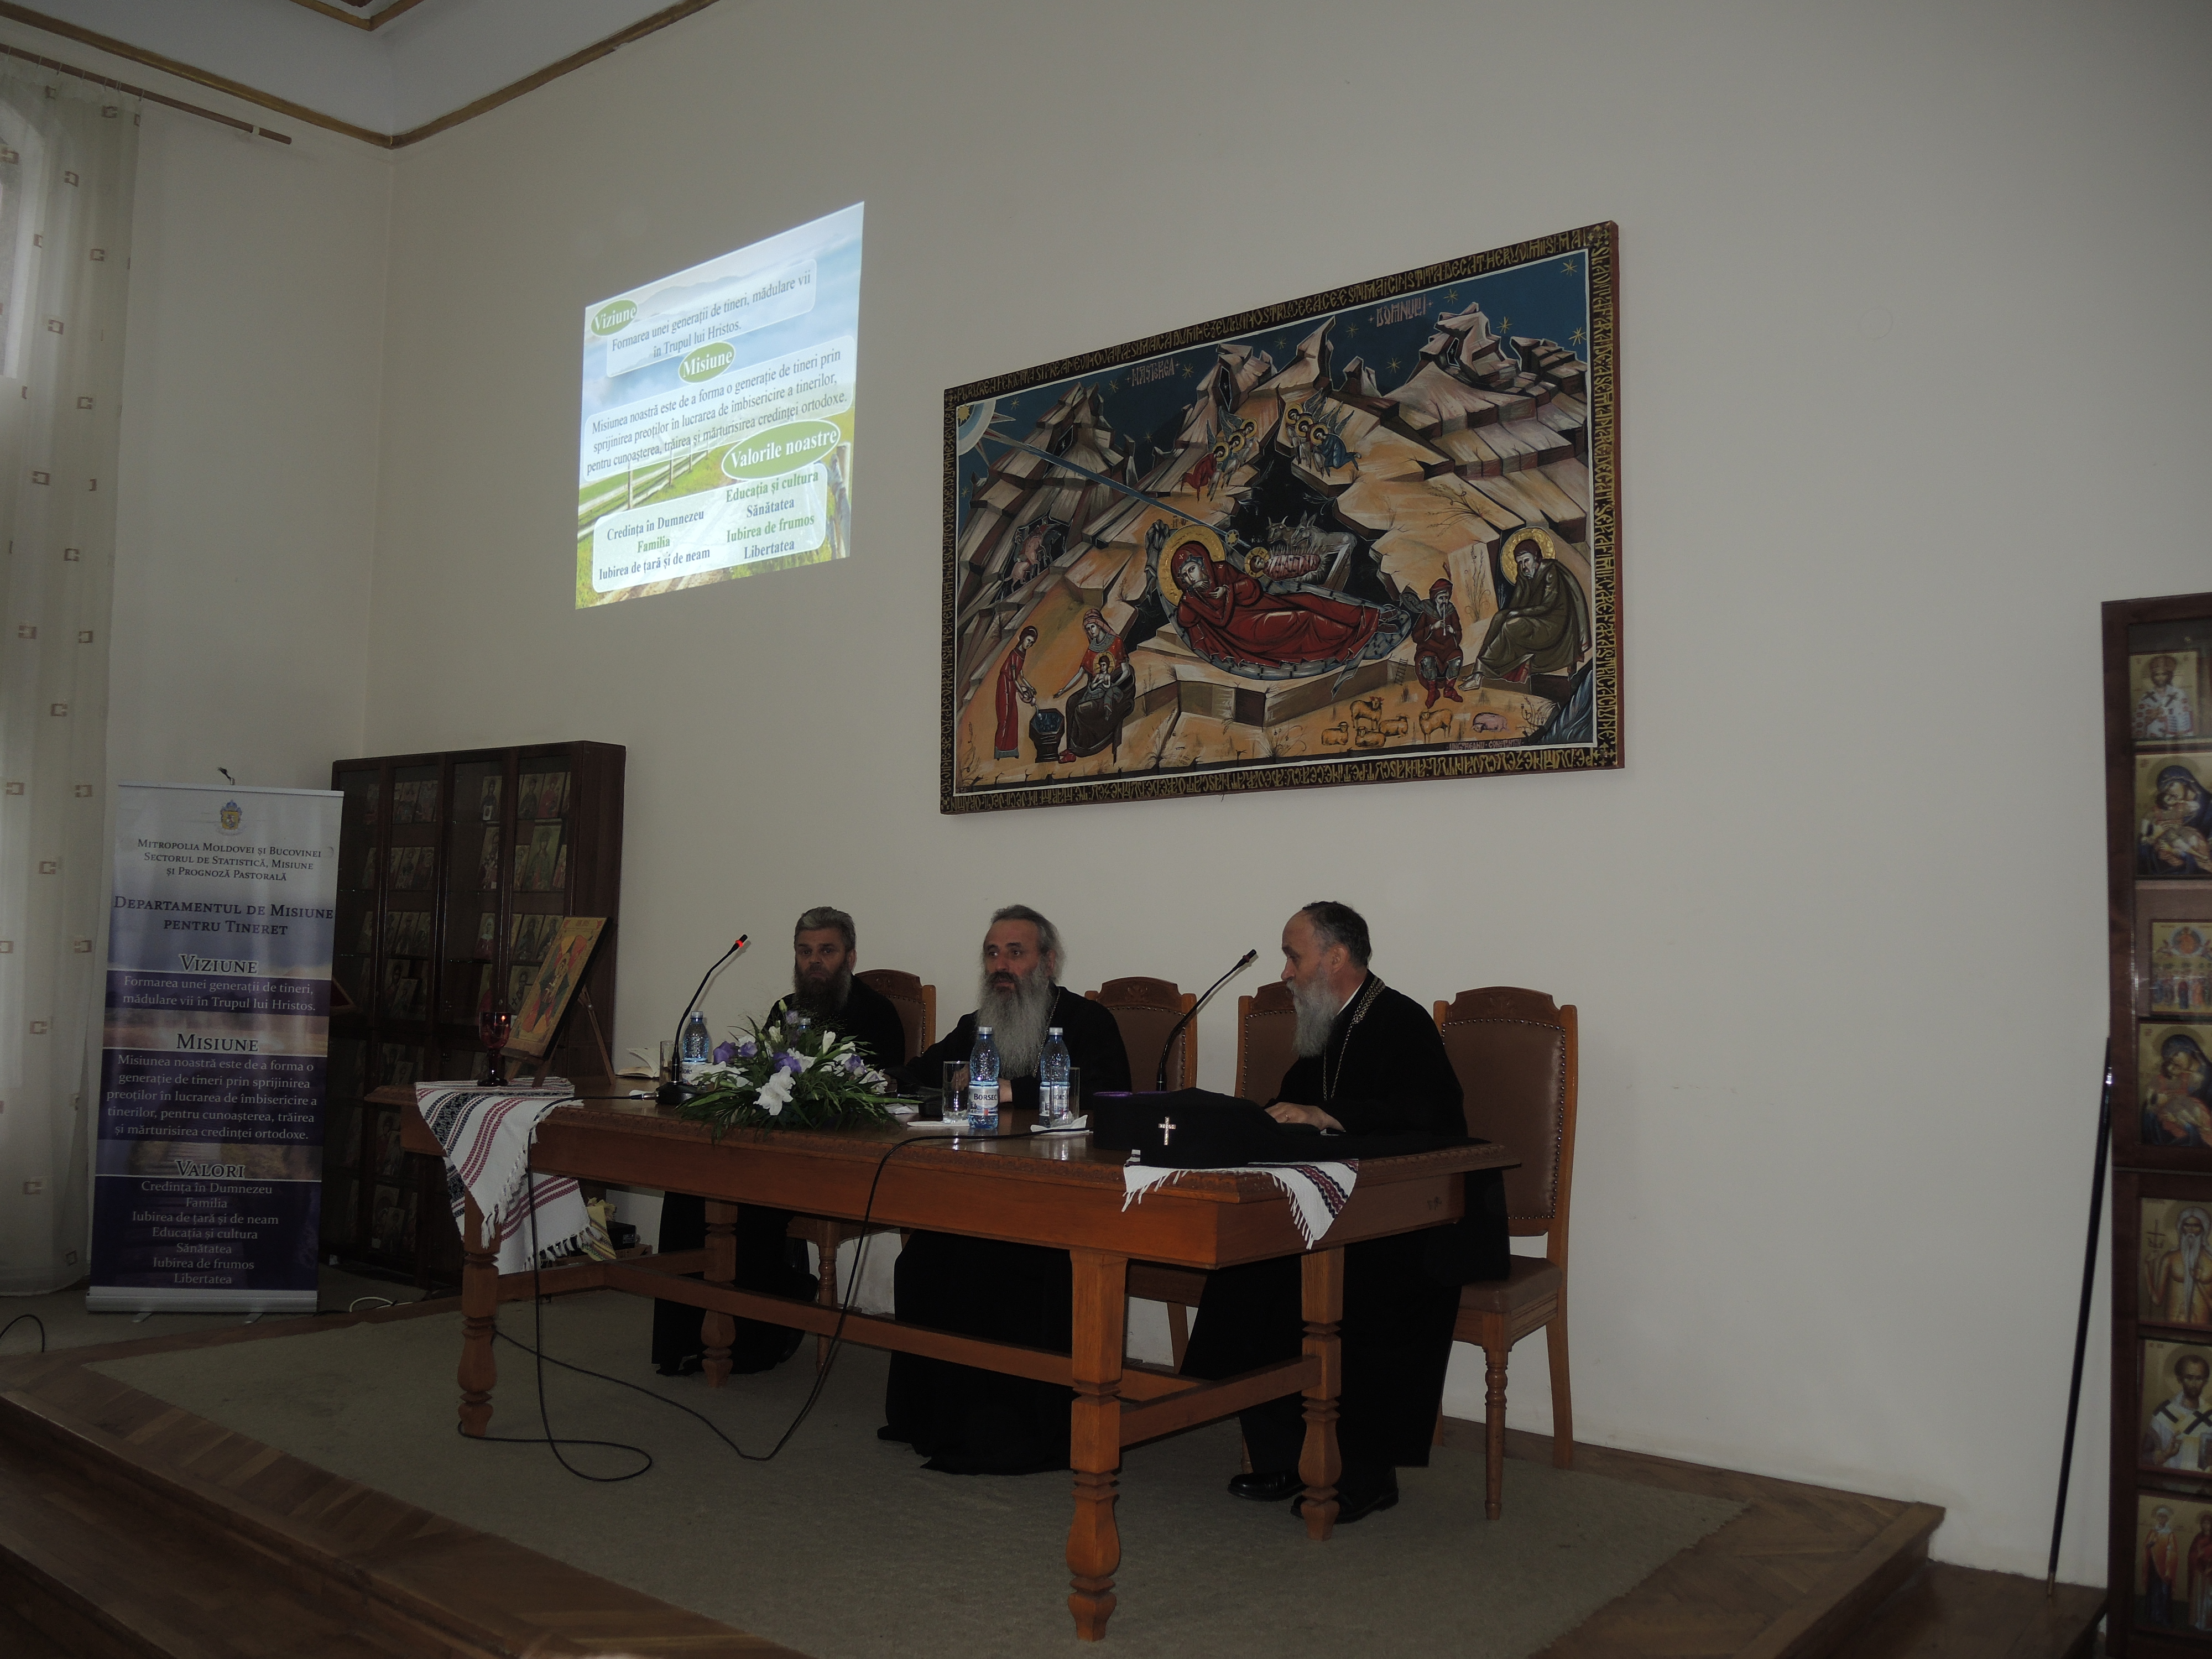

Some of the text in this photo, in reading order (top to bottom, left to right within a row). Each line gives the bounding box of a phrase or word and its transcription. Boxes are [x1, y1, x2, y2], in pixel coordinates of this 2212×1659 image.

[594, 307, 637, 331] Viziune
[611, 269, 811, 352] Formarea unei generații de tineri, mădulare vii
[653, 320, 742, 359] în Trupul lui Hristos.
[682, 350, 733, 378] Misiune
[592, 347, 841, 435] Misiunea noastră este de a forma o generație de tineri prin
[593, 372, 838, 455] sprijinirea preoților în lucrarea de îmbisericire a tinerilor,
[586, 392, 847, 476] pentru cunoașterea, trăirea și mărturisirea credinței ortodoxe.
[731, 430, 838, 468] Valorile noastre
[725, 471, 819, 503] Educația și cultura
[746, 498, 795, 518] Sănătatea
[607, 510, 705, 541] Credința în Dumnezeu
[726, 515, 815, 544] Iubirea de frumos
[637, 535, 671, 554] Familia
[743, 540, 795, 560] Libertatea
[598, 549, 711, 581] Iubirea de țară și de neam
[124, 975, 314, 995] Formarea unei generații de tineri,
[122, 993, 316, 1011] mădulare vii în Trupul lui Hristos.
[117, 1054, 171, 1067] Misiunea
[174, 1058, 217, 1068] noastră
[218, 1060, 242, 1070] este
[244, 1058, 259, 1070] de
[270, 1059, 304, 1072] forma
[306, 1064, 314, 1072] o
[118, 1073, 311, 1090] generație de tineri prin sprijinirea
[106, 1089, 317, 1106] preoților în lucrarea de îmbisericire a
[107, 1106, 315, 1123] tinerilor, pentru cunoașterea, trăirea
[114, 1123, 309, 1140] și mărturisirea credinței ortodoxe.
[141, 1181, 273, 1194] Credința în Dumnezeu
[185, 1197, 228, 1208] Familia
[132, 1211, 279, 1226] Iubirea de țară și de neam
[152, 1227, 258, 1241] Educația și cultura
[176, 1242, 232, 1254] Sănătatea
[153, 1256, 254, 1270] Iubirea de frumos
[174, 1272, 232, 1284] Libertatea
